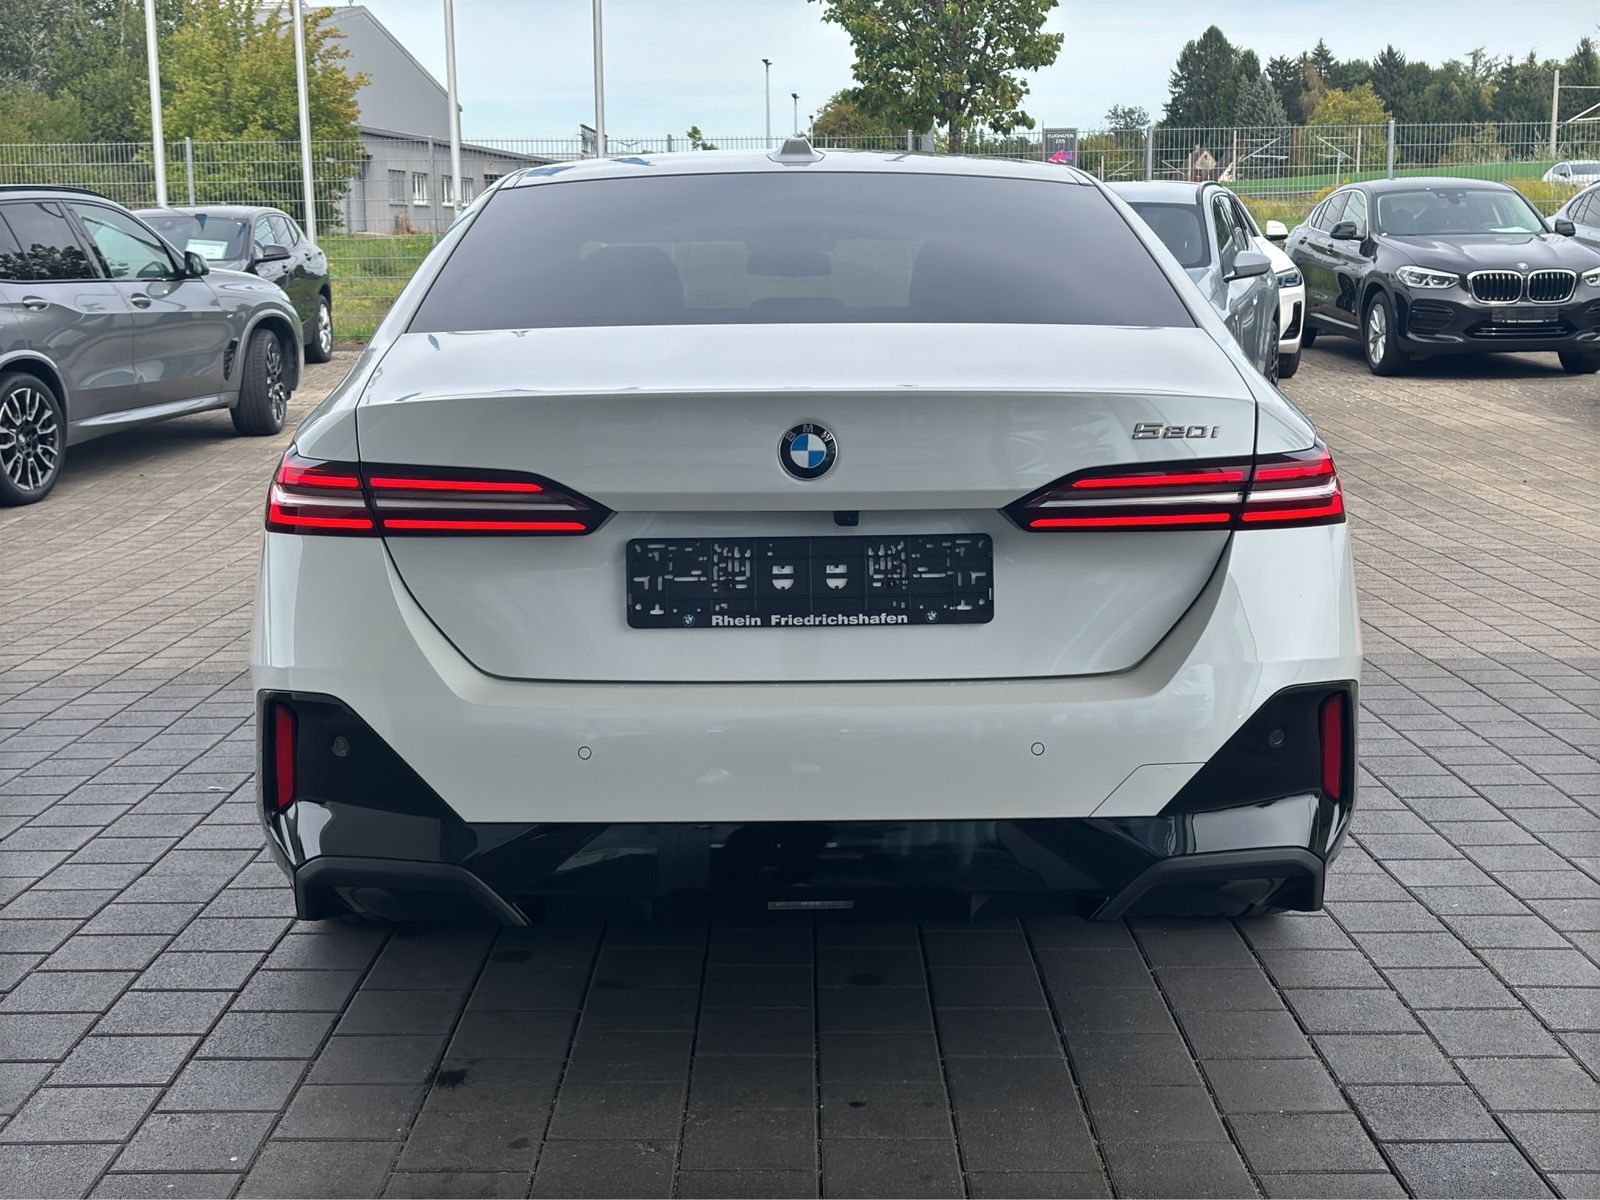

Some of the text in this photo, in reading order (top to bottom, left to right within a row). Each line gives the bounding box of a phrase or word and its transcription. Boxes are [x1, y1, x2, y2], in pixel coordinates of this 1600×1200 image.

[785, 424, 833, 442] BMW
[1132, 422, 1220, 440] 520i
[711, 612, 908, 626] Rhein Friedrichshafen
